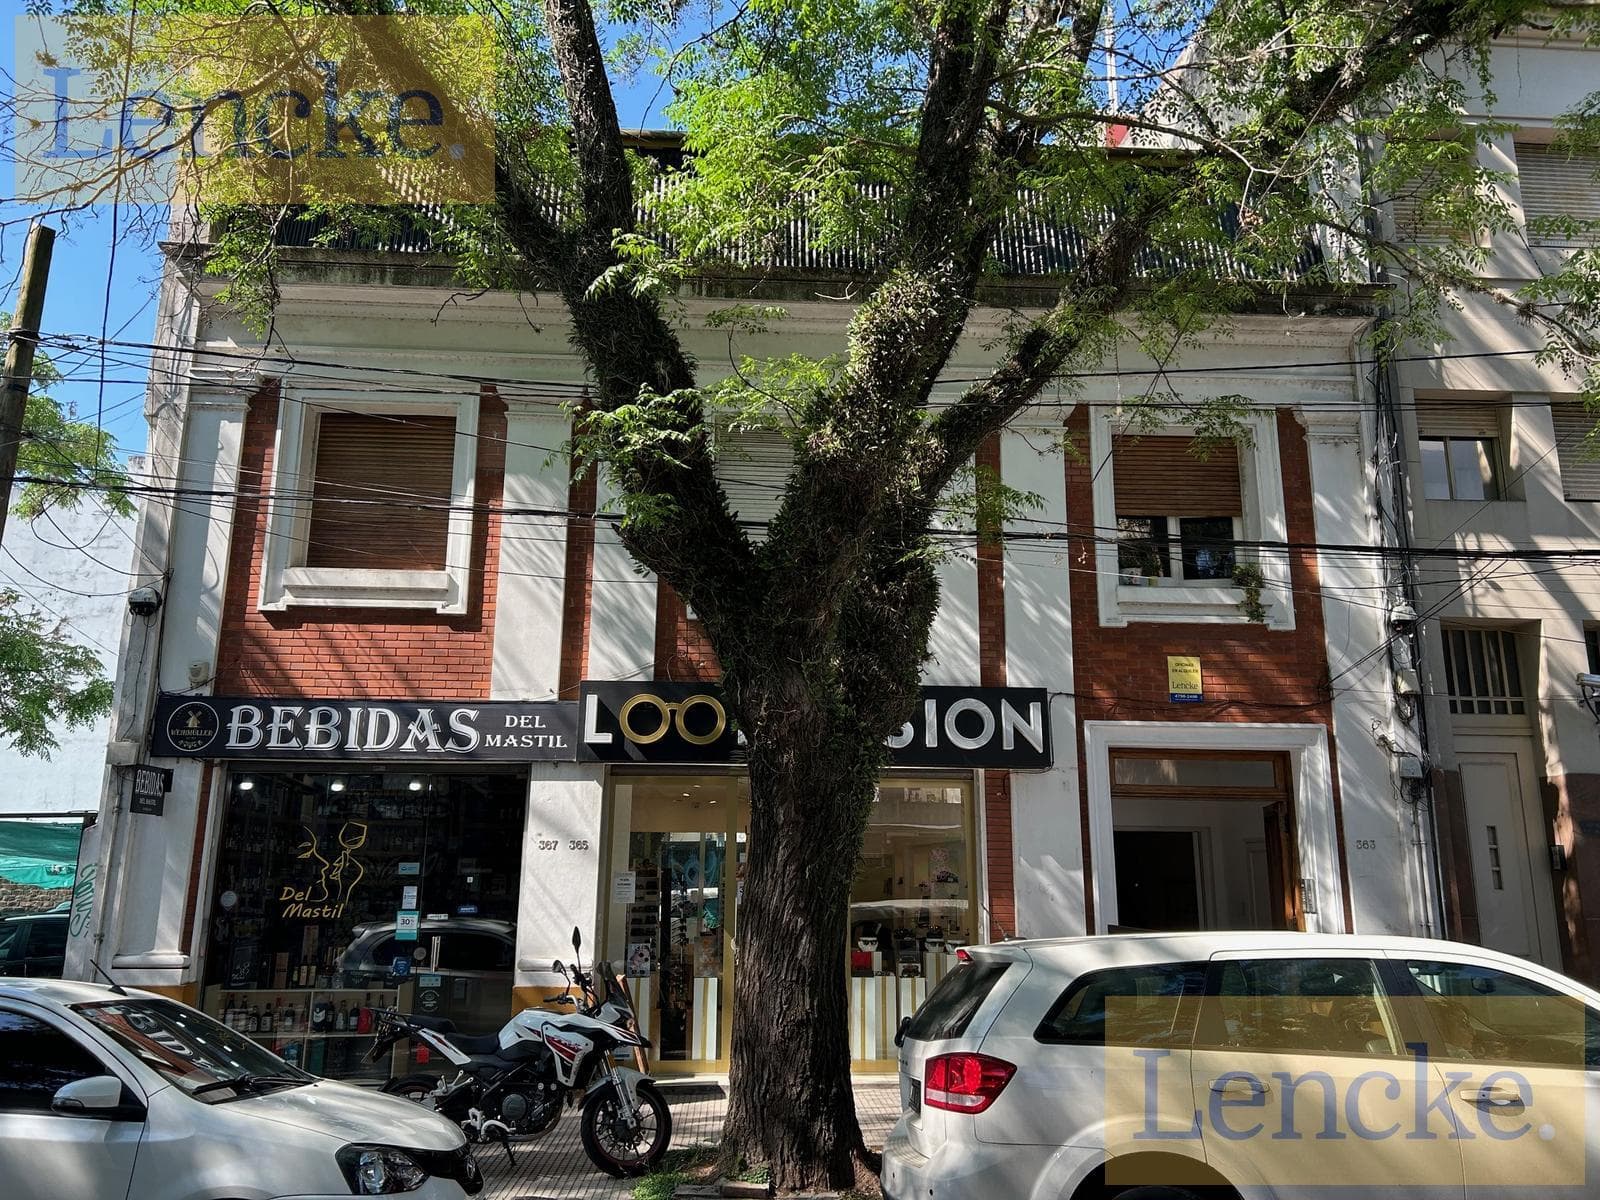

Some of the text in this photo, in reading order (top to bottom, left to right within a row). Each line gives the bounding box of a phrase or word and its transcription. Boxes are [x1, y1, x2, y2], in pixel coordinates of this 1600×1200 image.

[1172, 681, 1199, 690] Lencke
[505, 715, 547, 728] DEL
[584, 693, 748, 745] LOO
[225, 704, 480, 753] BEBIDAS
[484, 734, 568, 748] MASTIL
[135, 769, 165, 797] BEBIDAS
[539, 840, 589, 850] 367 365
[1356, 839, 1376, 850] 363
[279, 886, 312, 901] Del
[282, 903, 345, 918] Mastil
